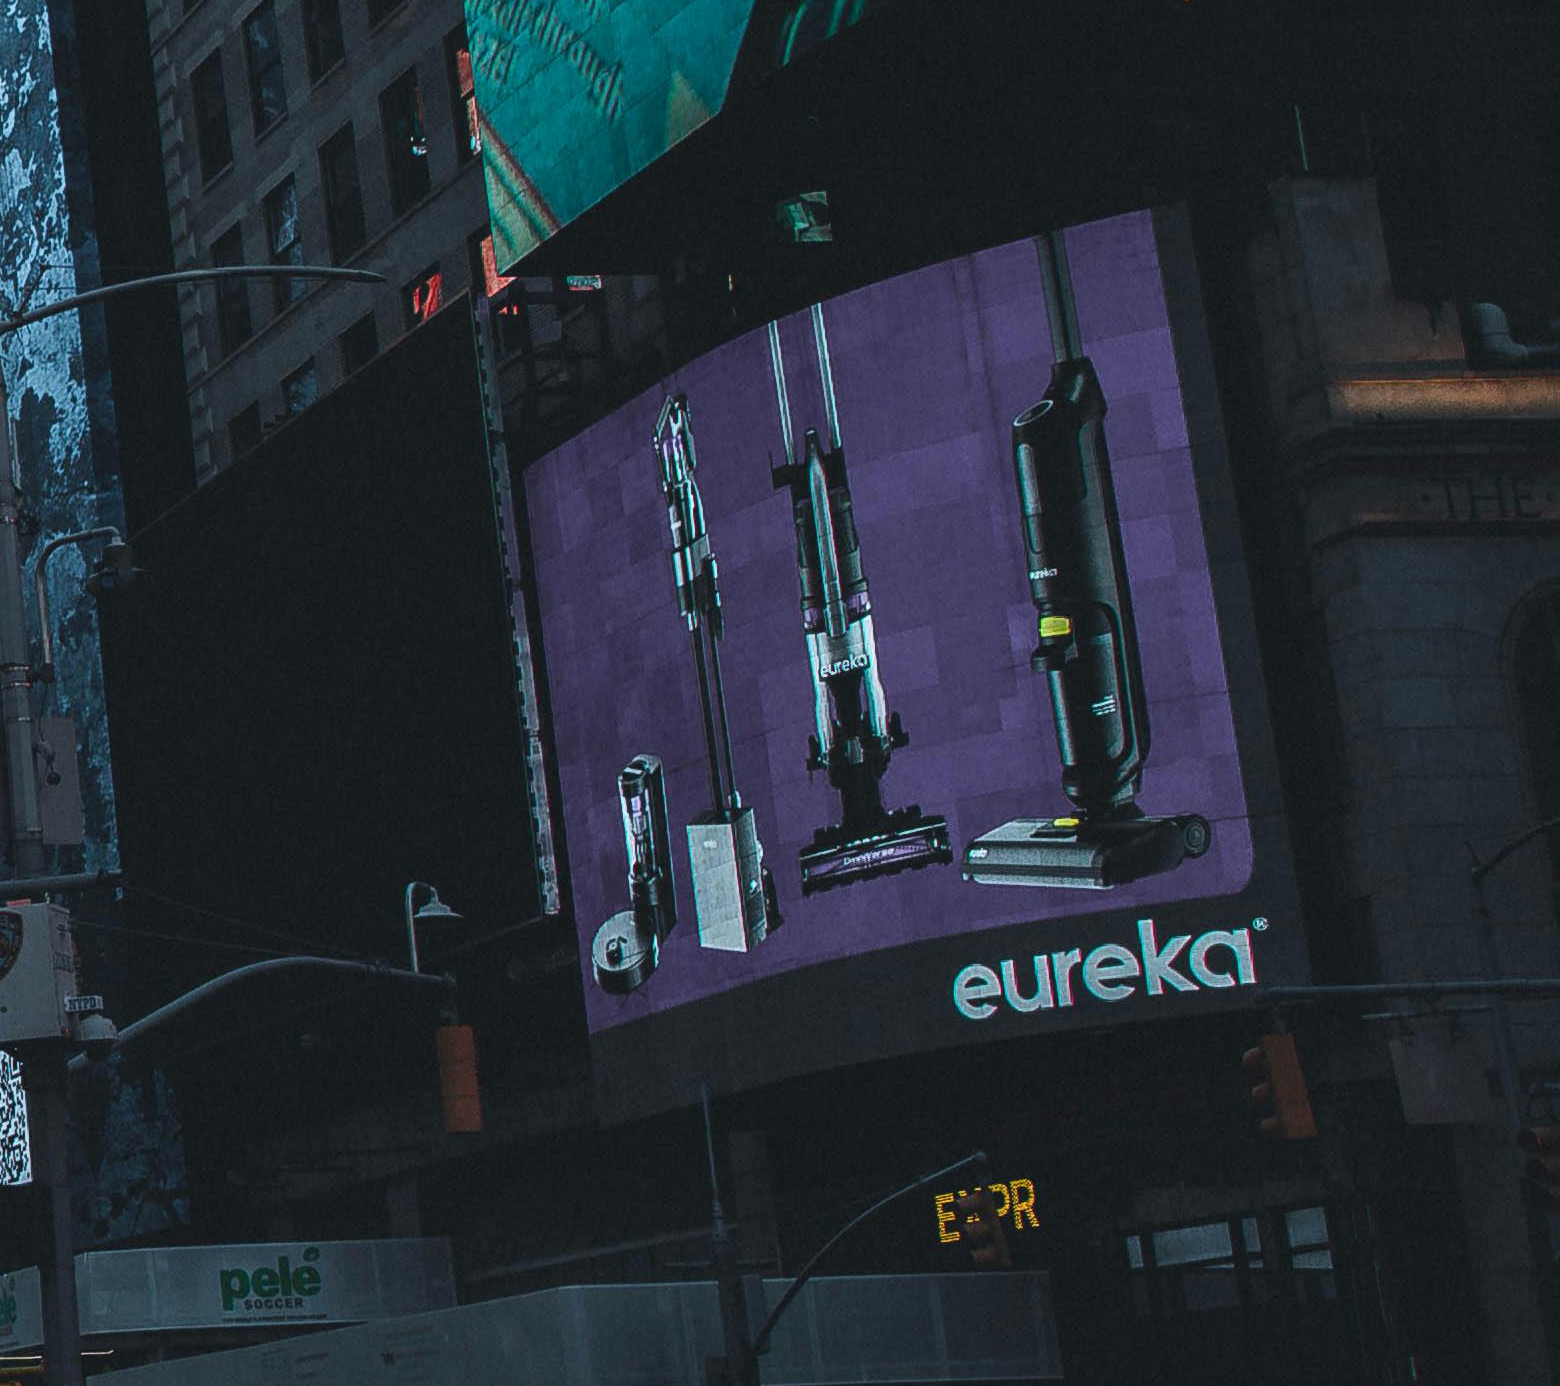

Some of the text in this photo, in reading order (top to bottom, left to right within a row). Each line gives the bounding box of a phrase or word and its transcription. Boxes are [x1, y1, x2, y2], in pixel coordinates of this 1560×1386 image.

[820, 654, 869, 679] eureka
[951, 918, 1258, 1021] eureka
[68, 997, 96, 1011] NYPD
[935, 1178, 1040, 1244] EPR
[220, 1245, 321, 1311] pelé
[244, 1297, 303, 1310] SOCCER
